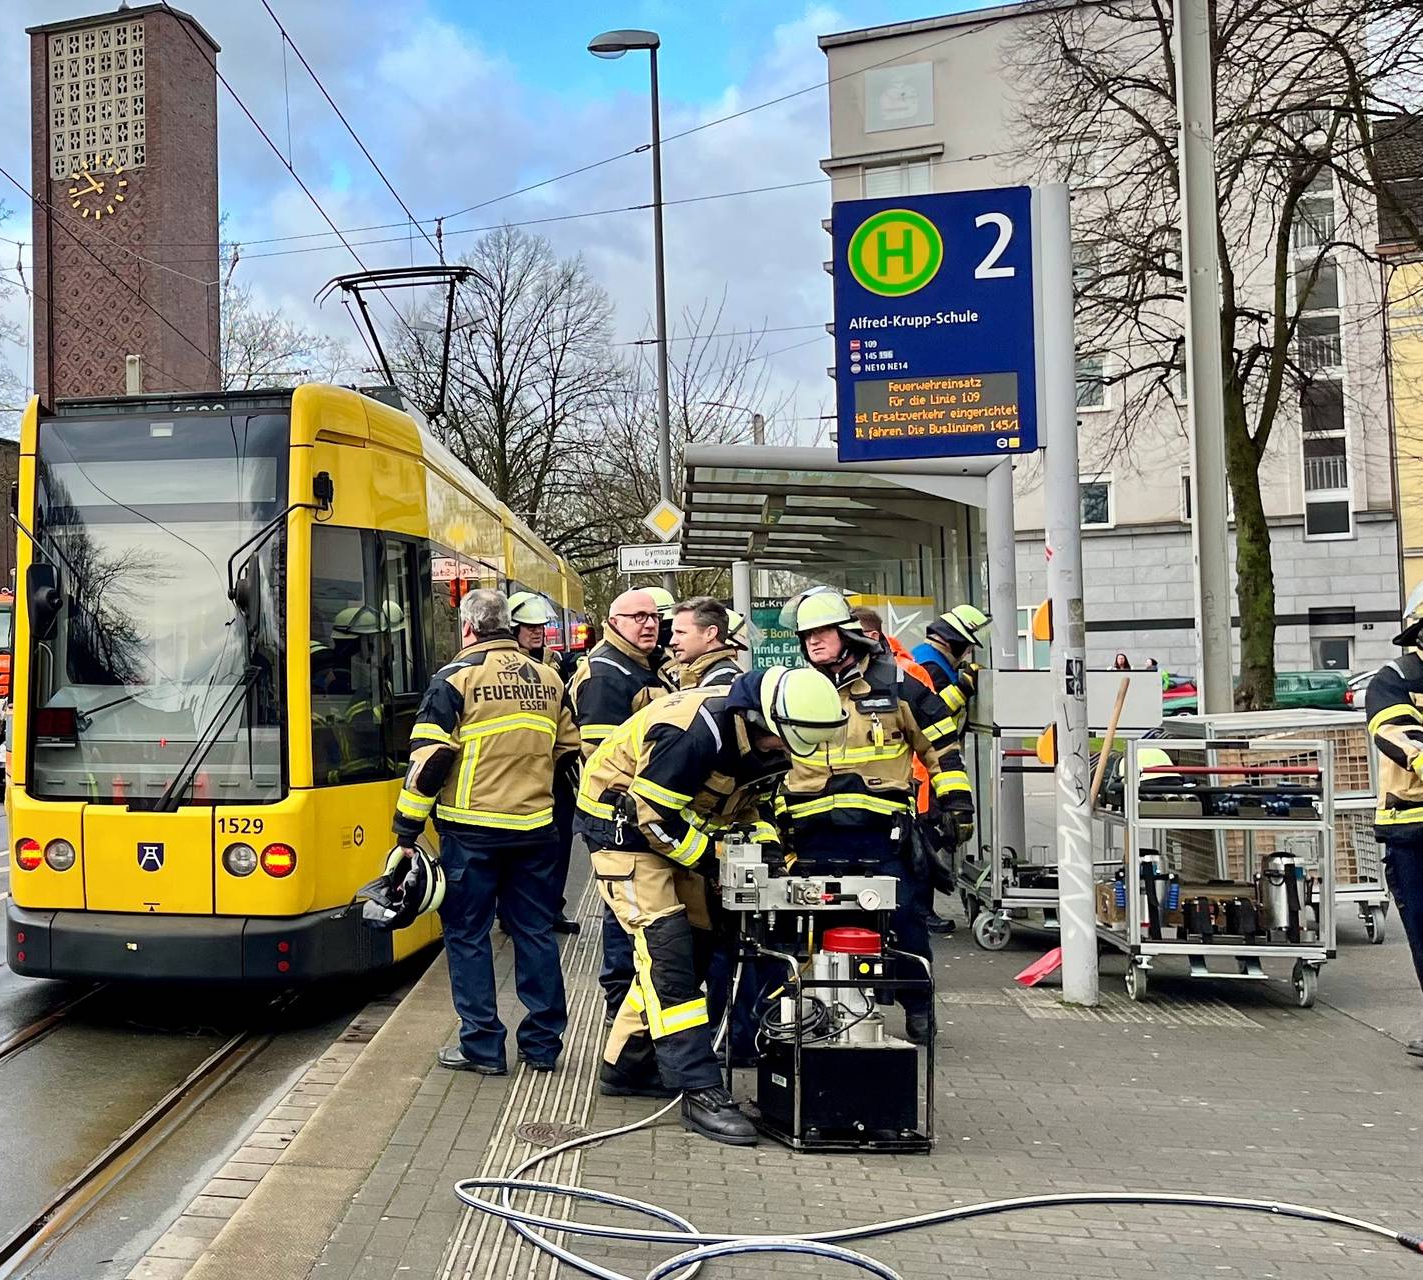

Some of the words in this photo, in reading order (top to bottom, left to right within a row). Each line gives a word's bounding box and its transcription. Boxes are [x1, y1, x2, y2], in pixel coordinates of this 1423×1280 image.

[974, 212, 1015, 280] 2
[877, 228, 914, 277] H
[849, 309, 978, 330] Alfred-Krupp-Schule
[864, 340, 877, 348] 109
[864, 351, 877, 360] 145
[864, 363, 885, 372] NE10
[887, 362, 908, 371] NE14
[888, 377, 982, 392] Feuerwehreinsatz
[909, 395, 926, 406] die
[930, 393, 957, 405] Linie
[961, 392, 980, 403] 109
[855, 413, 868, 424] ist
[872, 409, 946, 422] Ersatzverkehr
[950, 405, 1017, 421] eingerichtet
[907, 425, 925, 436] Die
[644, 548, 679, 557] Gymnasiu
[628, 559, 678, 567] Alfred-Krupp-
[770, 628, 797, 639] Bonu
[753, 643, 780, 655] mmle
[782, 643, 801, 654] Eur
[757, 656, 793, 668] REWE
[473, 684, 557, 703] FEUERWEHR
[520, 700, 548, 711] ESSEN
[217, 817, 264, 835] 1529
